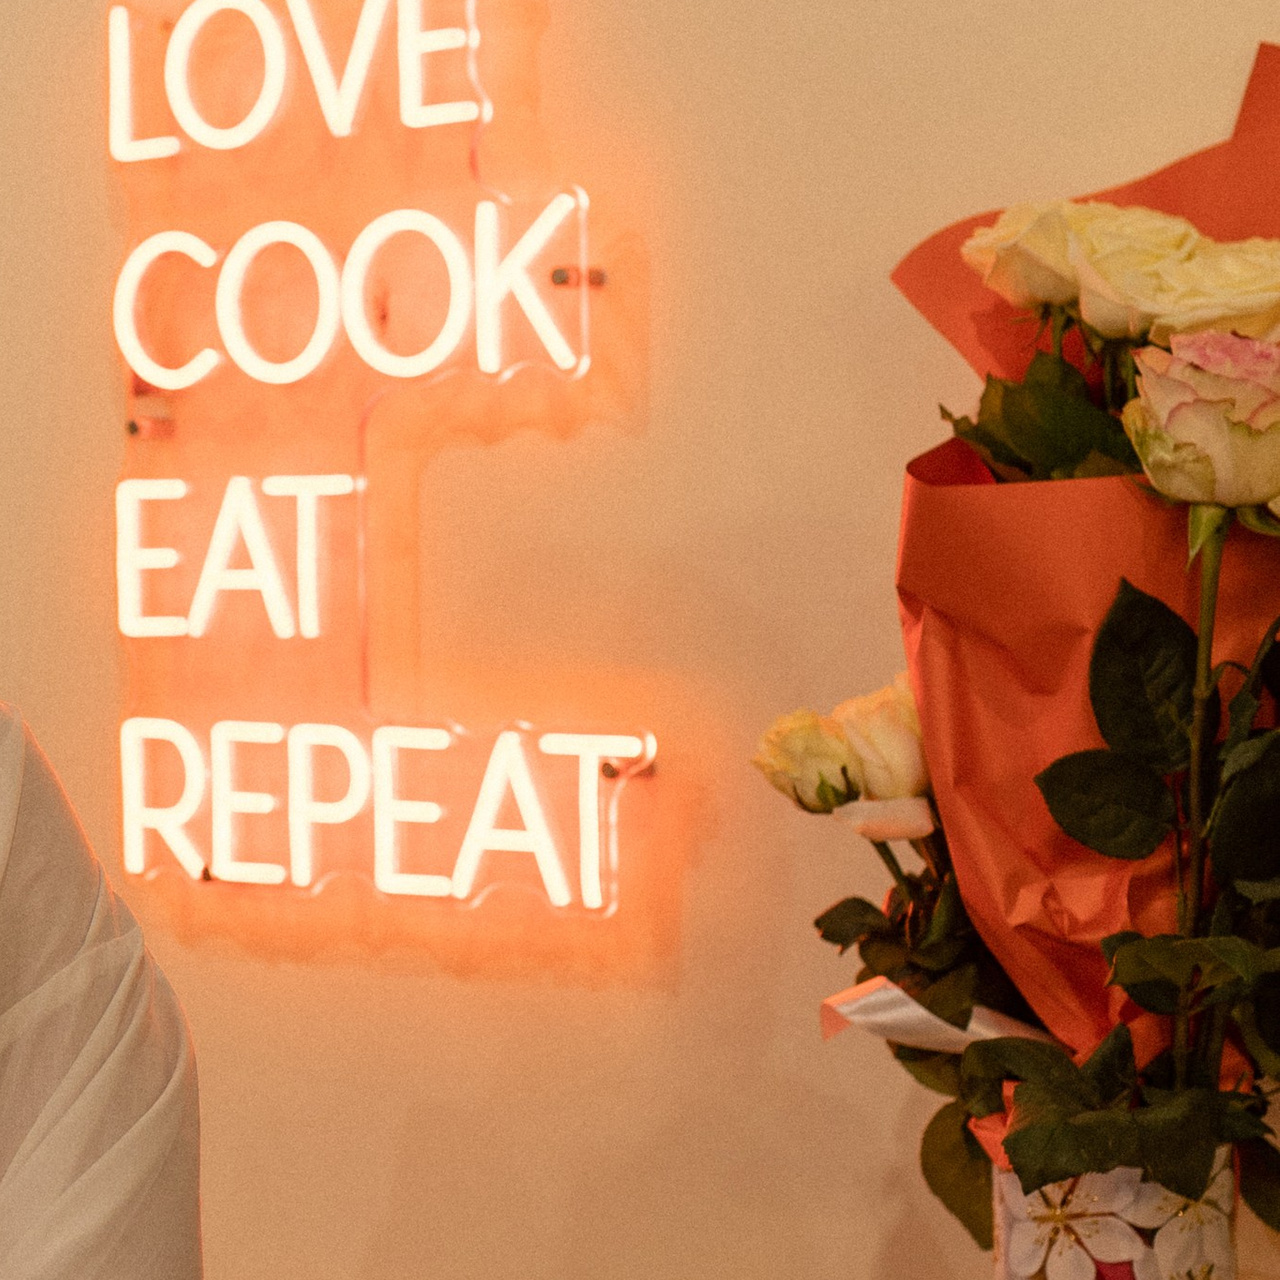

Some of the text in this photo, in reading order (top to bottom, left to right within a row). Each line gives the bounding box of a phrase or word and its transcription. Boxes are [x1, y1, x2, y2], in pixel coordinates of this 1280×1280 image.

[112, 193, 578, 390] COOK
[116, 474, 356, 639] EAT
[119, 717, 644, 909] REPEAT
